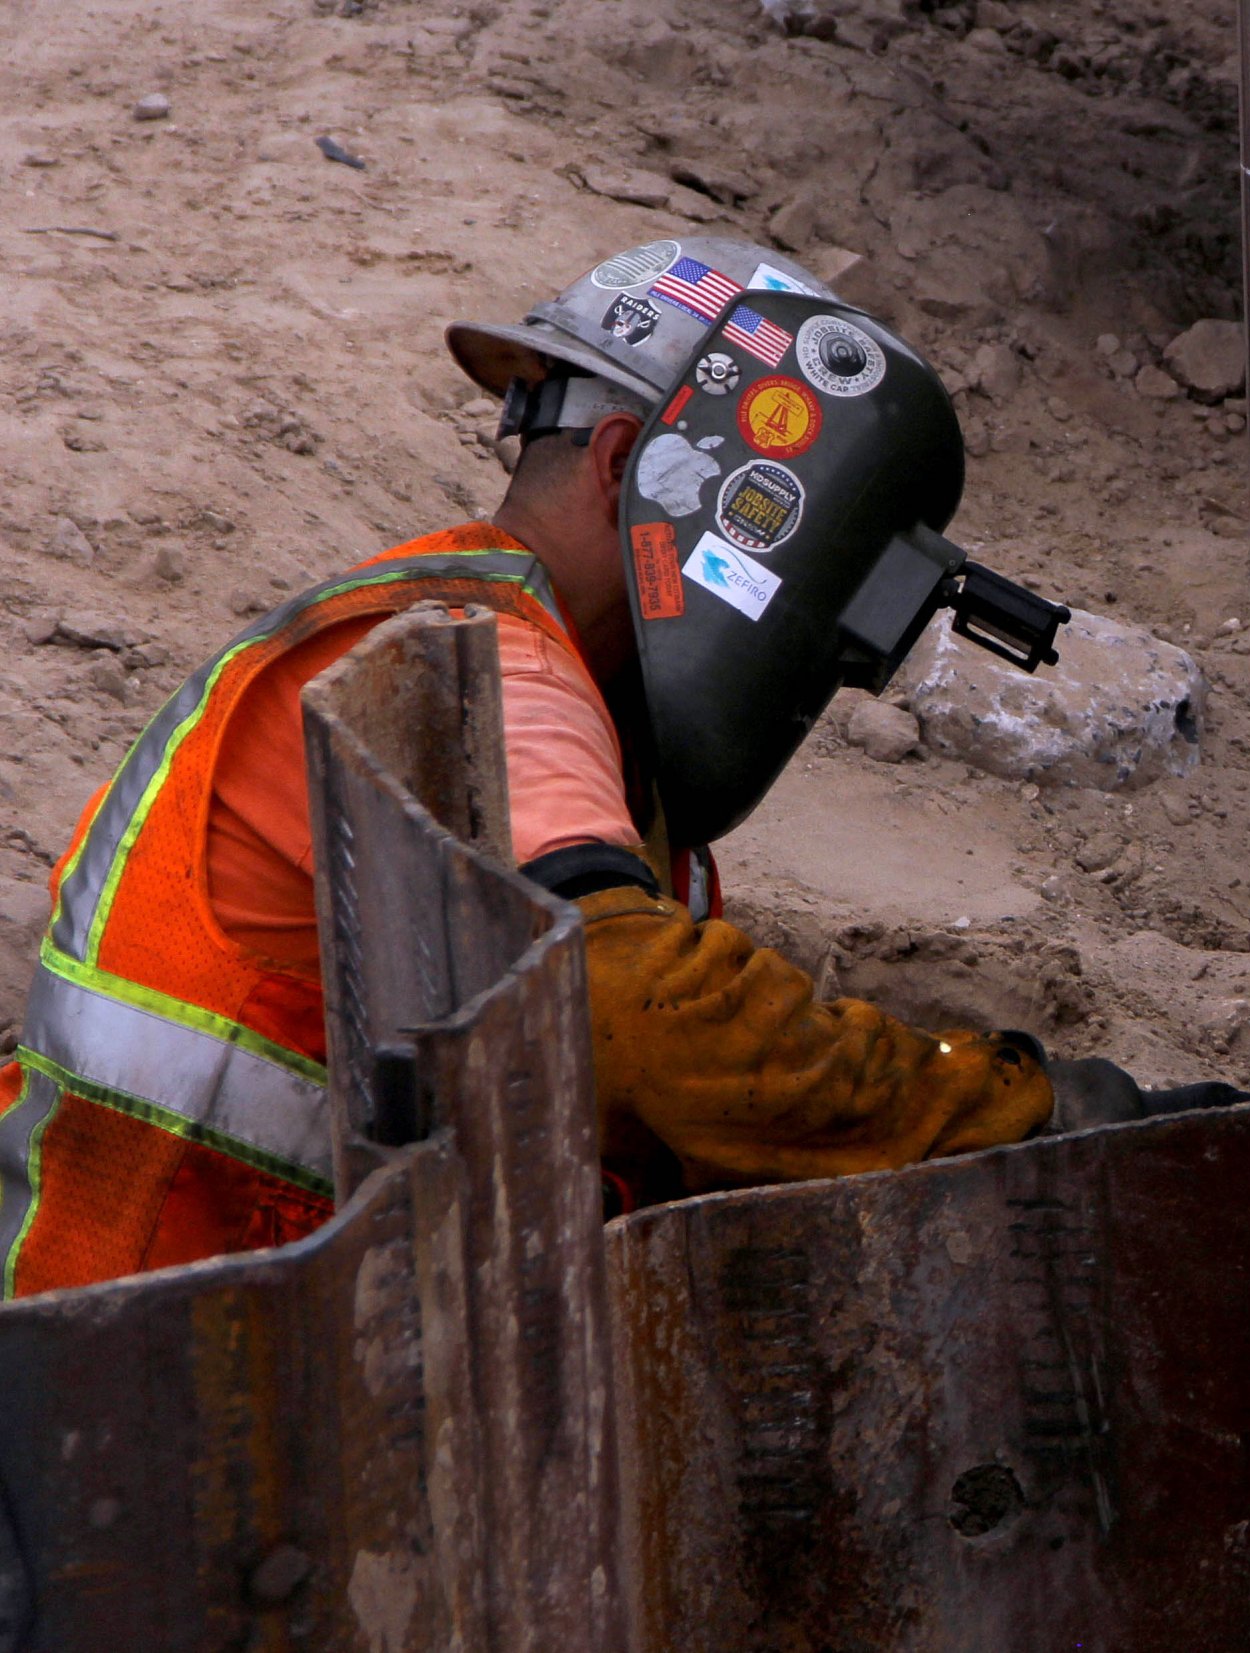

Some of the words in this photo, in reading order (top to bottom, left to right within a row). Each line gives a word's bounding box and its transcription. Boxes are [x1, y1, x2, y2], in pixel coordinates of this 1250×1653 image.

[621, 296, 660, 320] RAIDERS
[812, 325, 855, 345] JOBSITE
[859, 339, 875, 380] SAFETY
[805, 360, 829, 387] WHITE
[830, 384, 849, 393] CAP
[731, 497, 782, 533] SAFETY
[738, 486, 787, 520] JOBSITE
[727, 571, 767, 602] ZEFIRO
